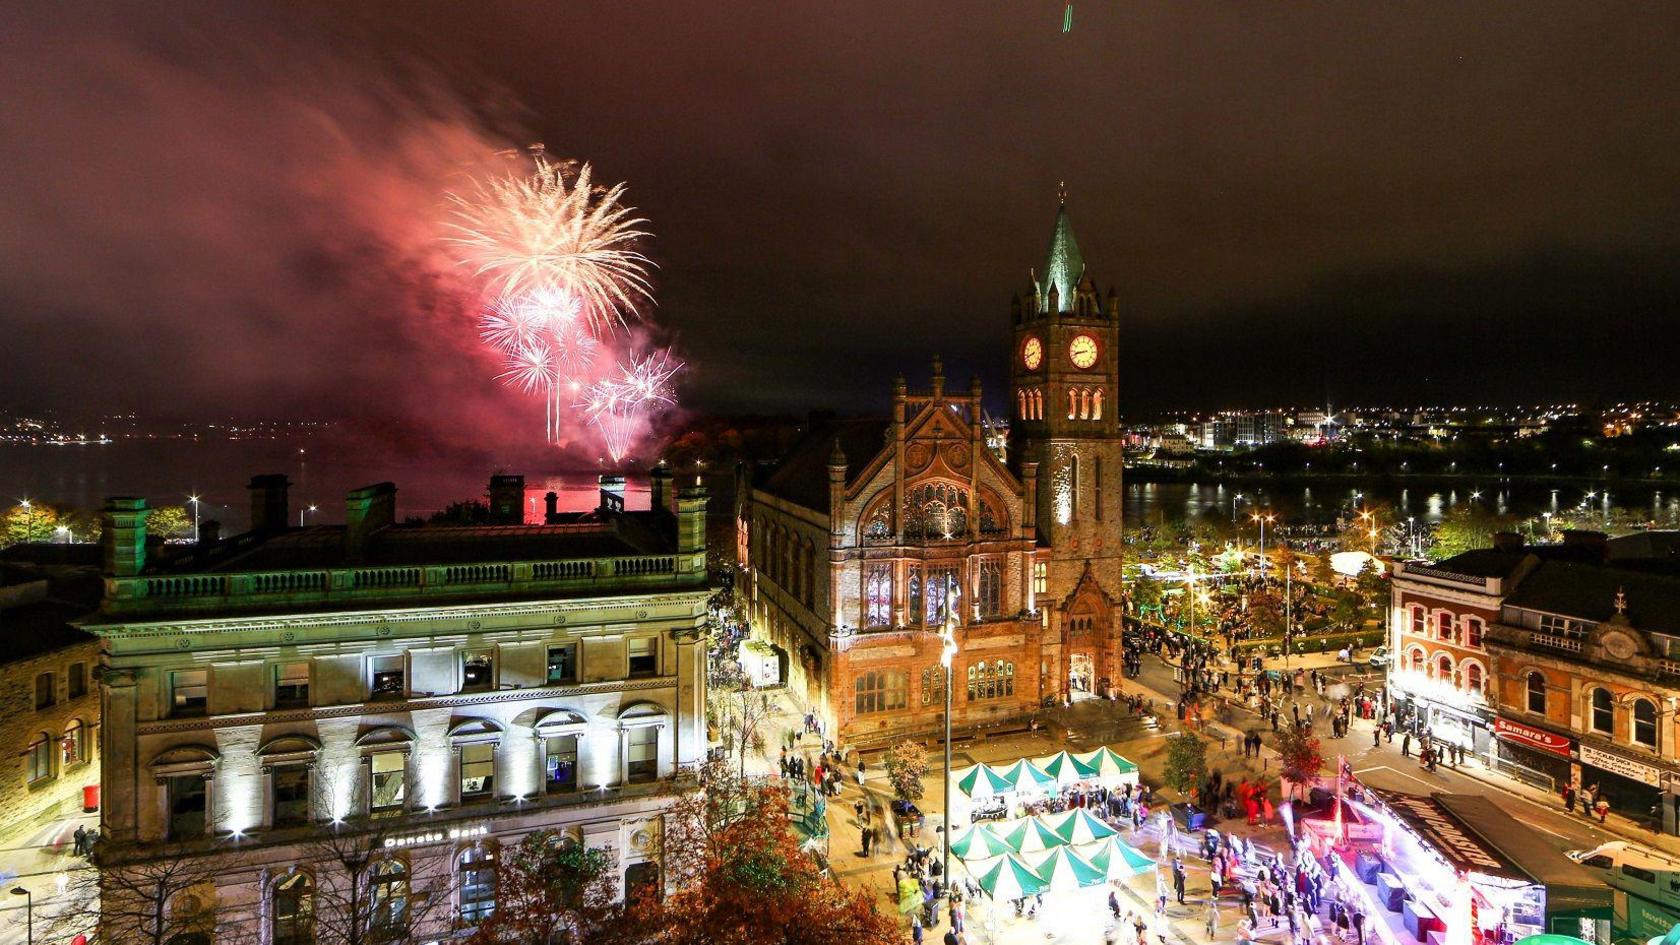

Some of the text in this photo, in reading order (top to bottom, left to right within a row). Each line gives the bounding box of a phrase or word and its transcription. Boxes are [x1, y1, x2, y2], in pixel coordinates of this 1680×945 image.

[1499, 720, 1552, 744] Samara's
[384, 825, 488, 848] Danske Bank
